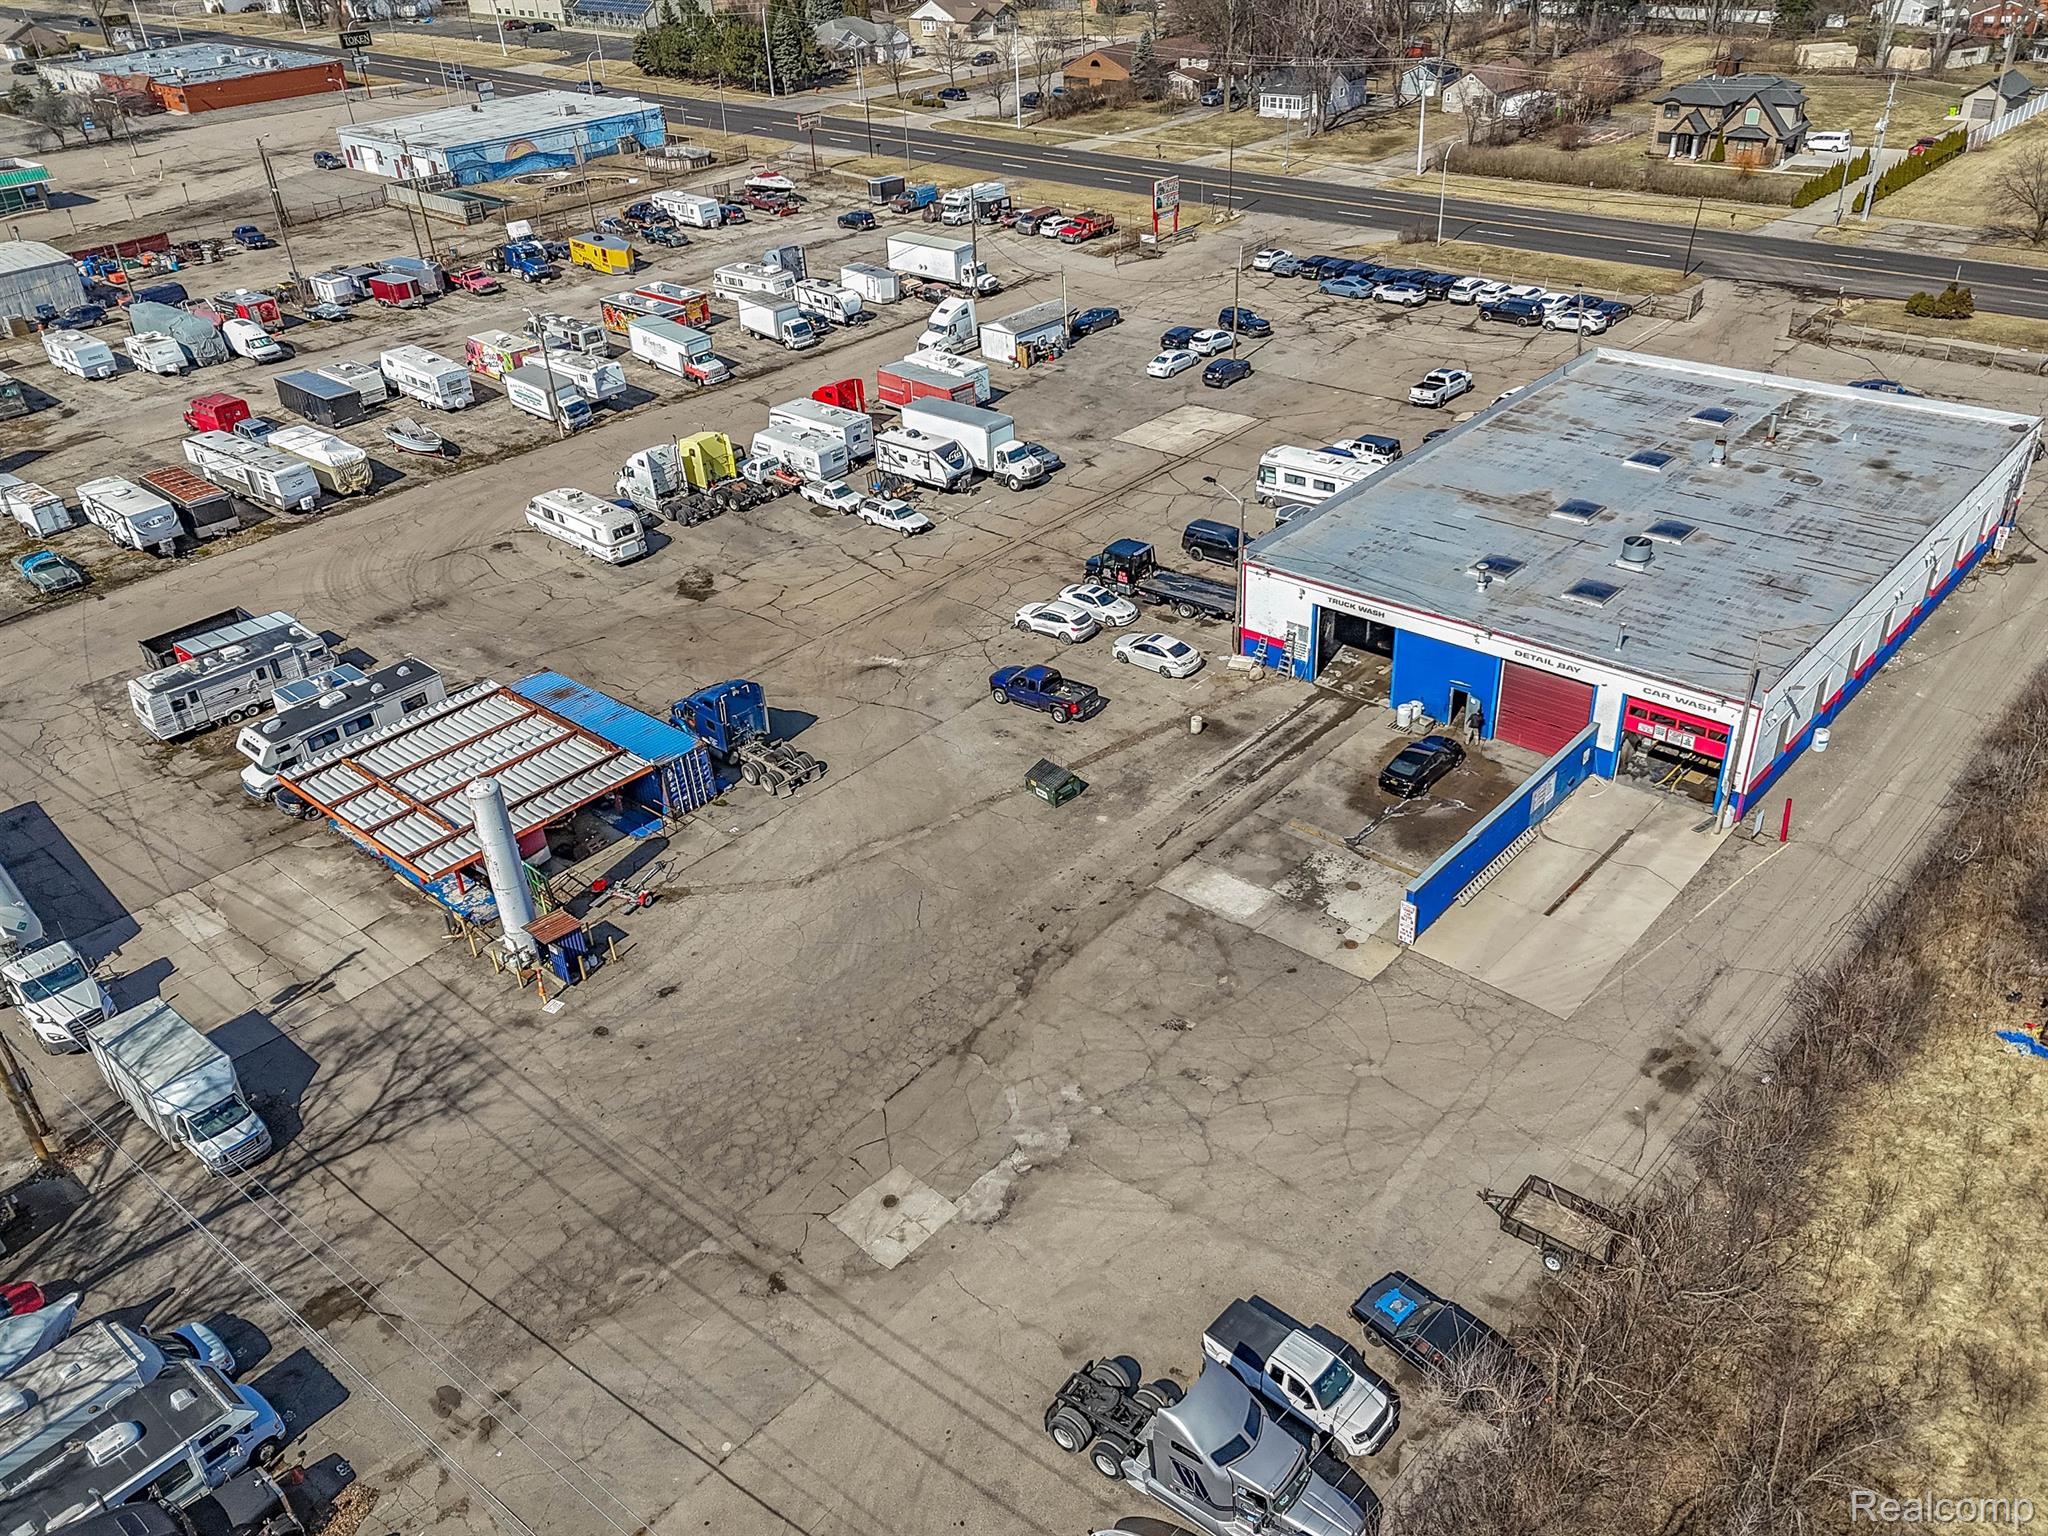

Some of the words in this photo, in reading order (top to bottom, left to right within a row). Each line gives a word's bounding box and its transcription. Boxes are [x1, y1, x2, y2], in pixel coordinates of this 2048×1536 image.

[343, 32, 371, 46] TOKEN
[1327, 597, 1356, 610] TRUCK
[1358, 605, 1386, 618] WASH
[1514, 650, 1554, 666] DETAIL
[1557, 662, 1581, 673] BAY
[1643, 687, 1671, 700] CAR
[1675, 696, 1718, 714] WASH
